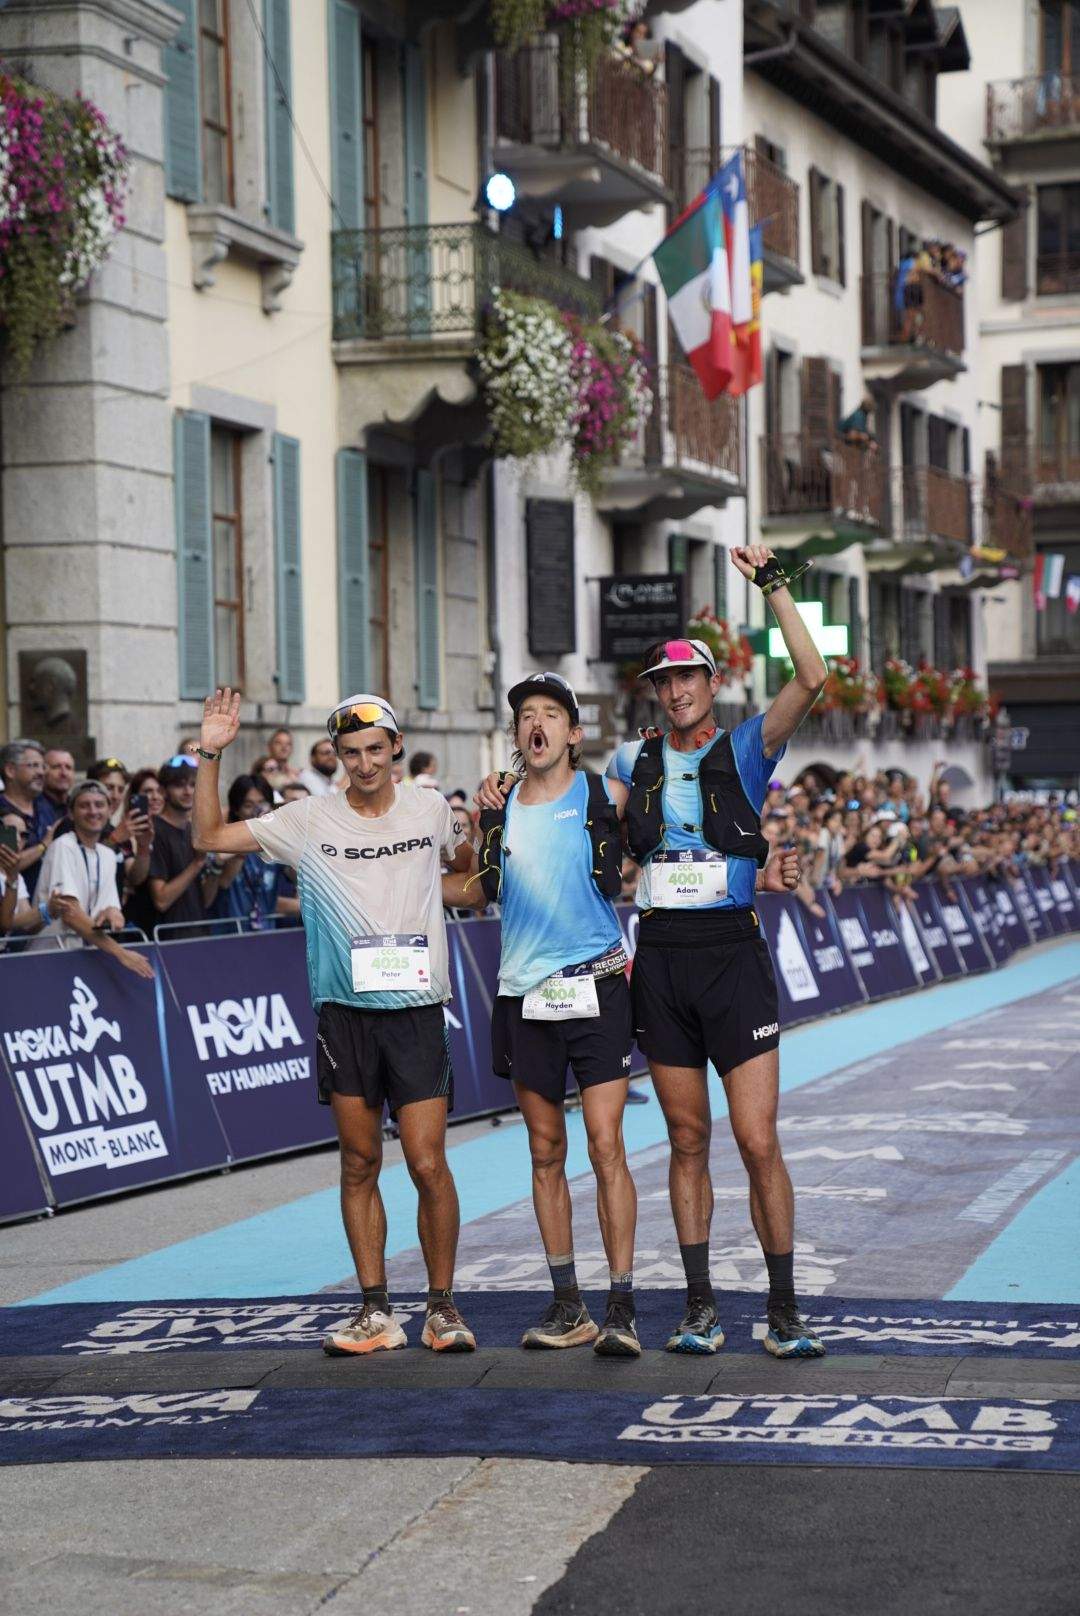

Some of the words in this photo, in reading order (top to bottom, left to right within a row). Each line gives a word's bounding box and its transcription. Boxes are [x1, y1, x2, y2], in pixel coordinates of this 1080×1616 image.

[554, 809, 578, 820] HOKA
[344, 836, 432, 859] SCARPA
[668, 873, 703, 885] 4001
[371, 957, 409, 969] 4025
[540, 987, 576, 1000] 4004
[546, 1002, 573, 1010] Hayden
[187, 994, 304, 1061] HOKA
[753, 1022, 778, 1040] HOKA
[4, 1025, 72, 1064] HOKA
[206, 1071, 232, 1095] FLY
[231, 1061, 290, 1091] HUMAN
[286, 1056, 310, 1081] FLY
[15, 1054, 147, 1130] UTMB
[50, 1130, 160, 1166] MONT-BLANC
[841, 1316, 1019, 1328] HUMAN
[1027, 1321, 1080, 1329] LY
[222, 1331, 329, 1345] OKA
[0, 1390, 261, 1417] OKA
[143, 1415, 230, 1426] FLY
[641, 1400, 1058, 1432] UTMB
[639, 1429, 1034, 1448] MONT-BLANC
